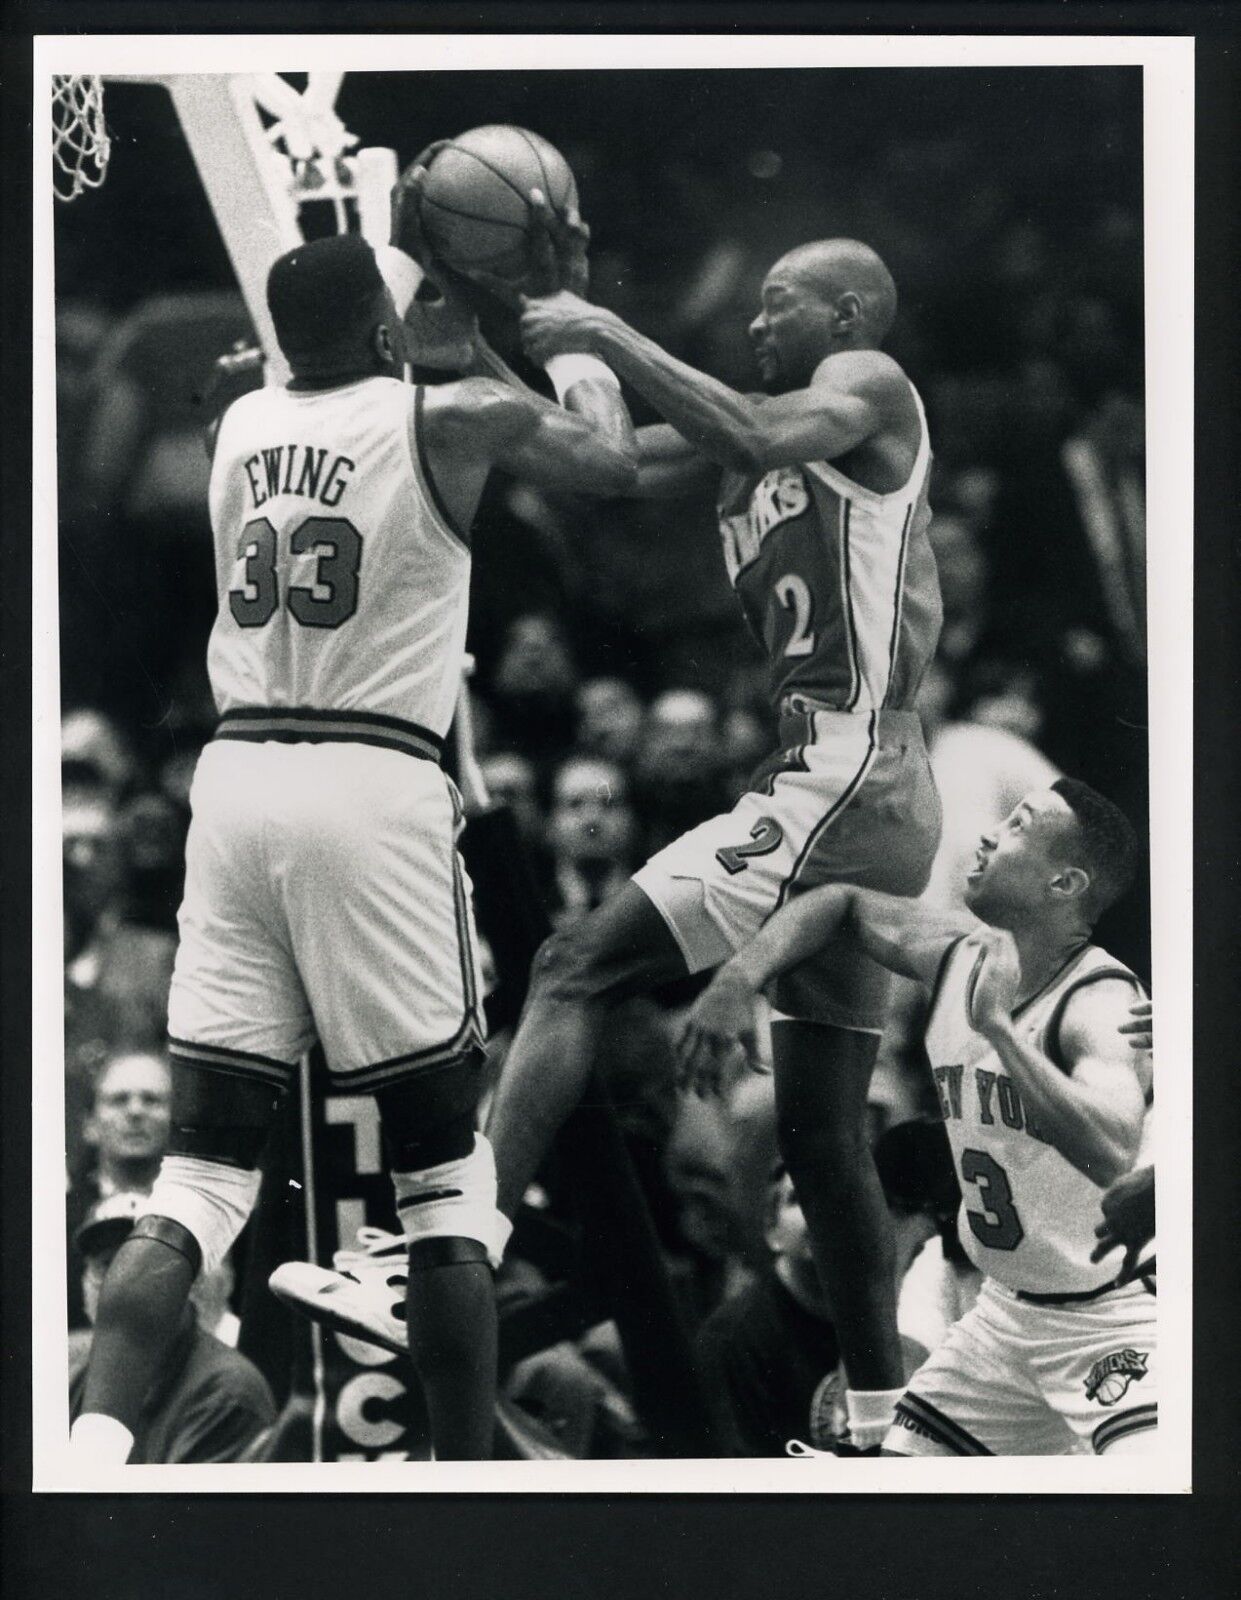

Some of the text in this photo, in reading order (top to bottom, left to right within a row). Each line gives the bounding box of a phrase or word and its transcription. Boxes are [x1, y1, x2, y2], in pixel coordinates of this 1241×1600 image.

[244, 444, 356, 509] EWING
[228, 516, 364, 630] 33
[774, 573, 815, 657] 2
[715, 816, 783, 875] 2
[960, 1147, 1025, 1251] 3
